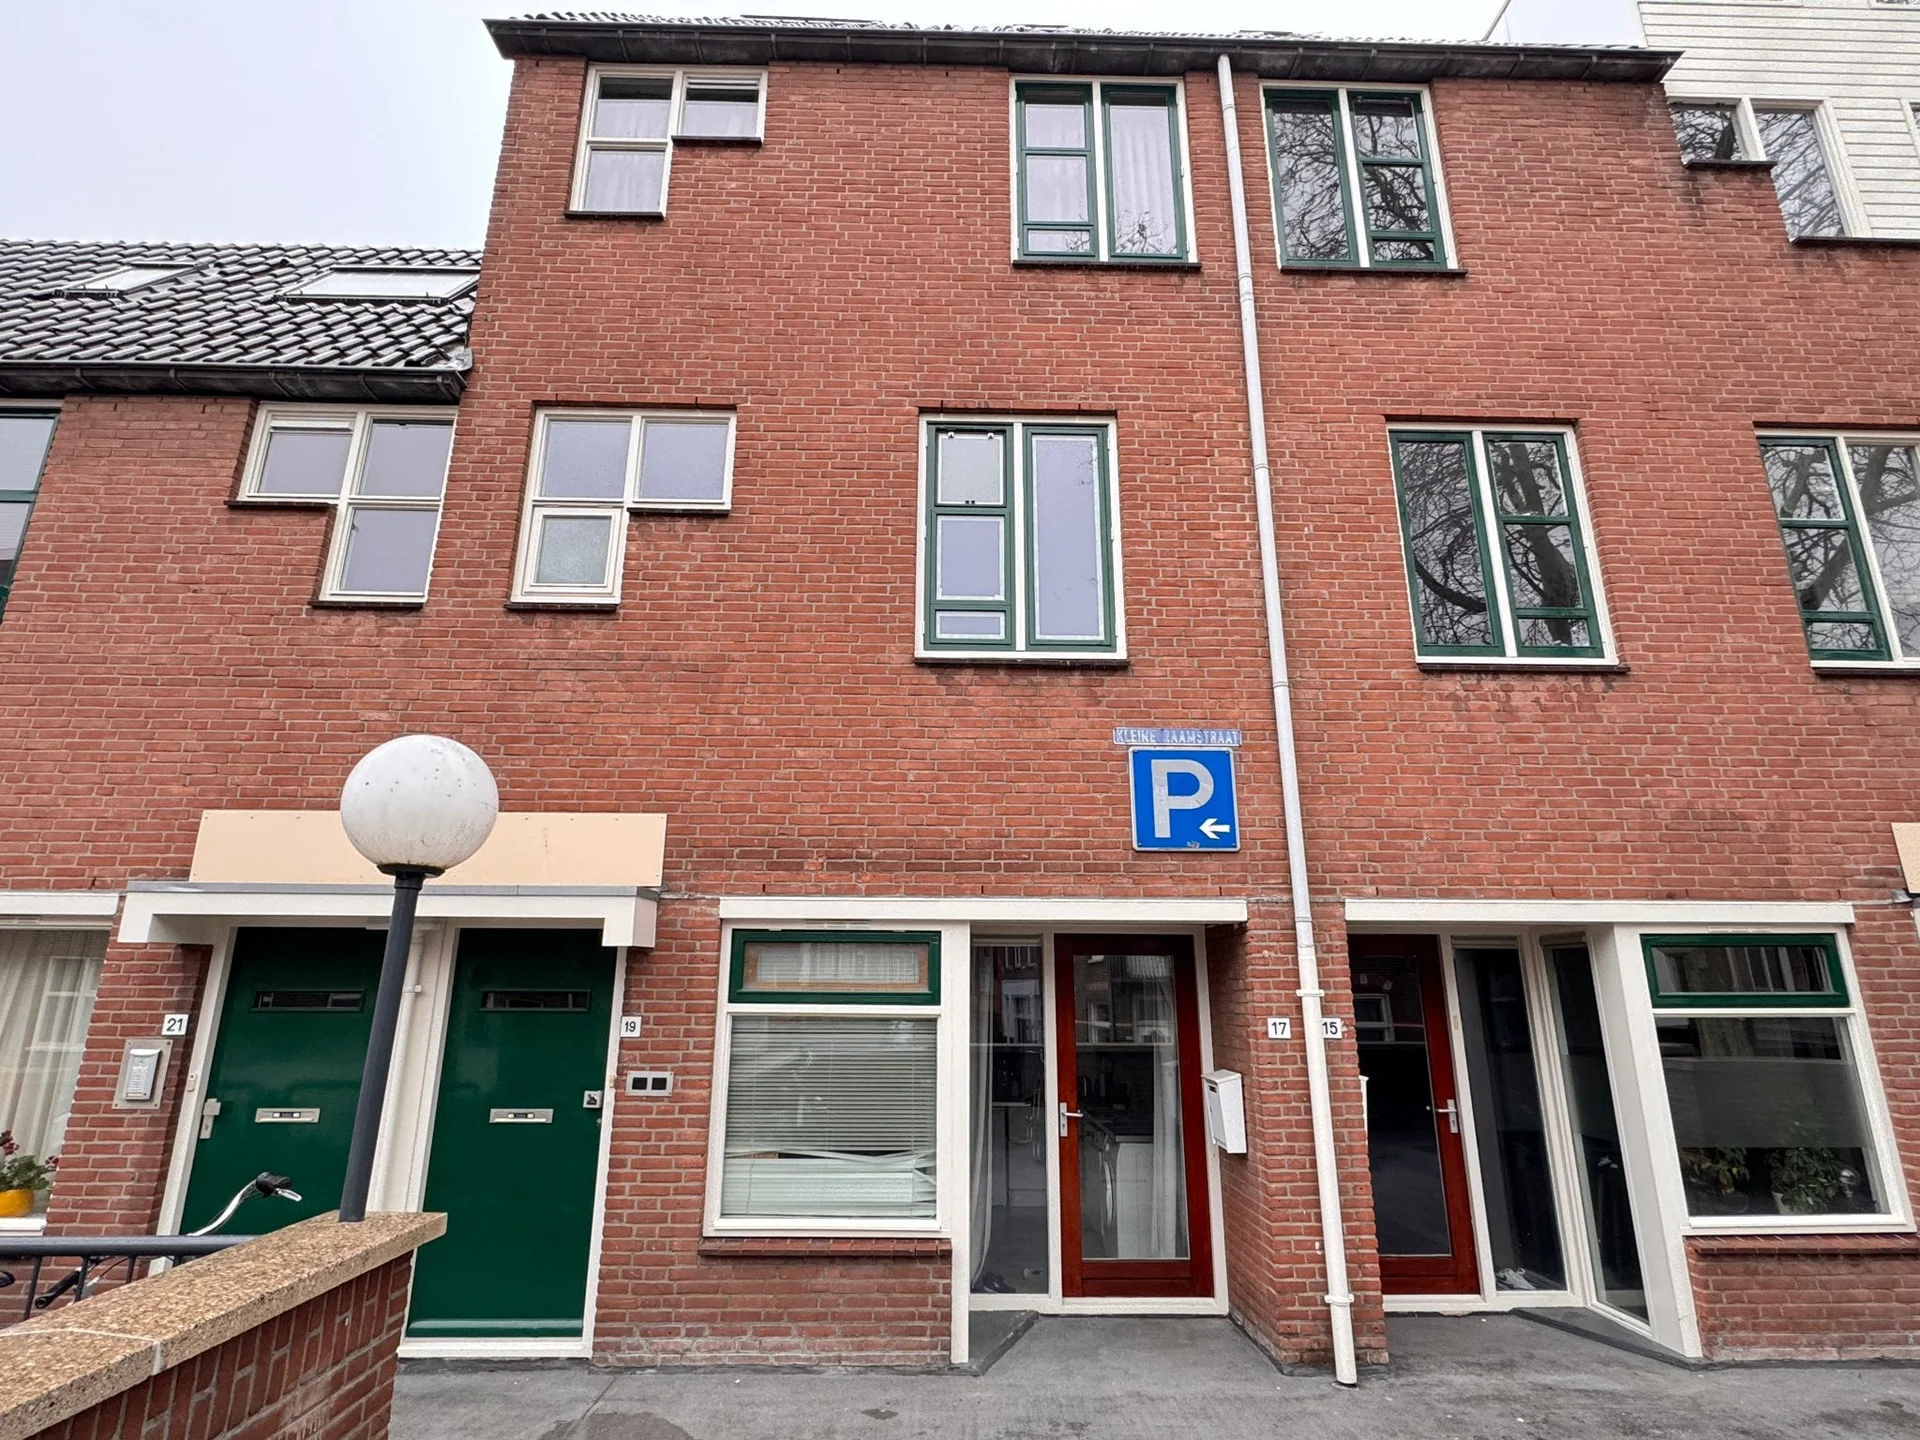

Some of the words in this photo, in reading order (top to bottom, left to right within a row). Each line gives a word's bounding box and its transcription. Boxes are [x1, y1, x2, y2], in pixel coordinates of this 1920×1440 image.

[1116, 729, 1156, 742] KLEINE
[1163, 730, 1238, 744] RAAMSTRAAT
[1151, 759, 1214, 838] P
[166, 1018, 183, 1032] 21
[625, 1021, 636, 1032] 19
[1271, 1022, 1287, 1035] 17
[1322, 1022, 1338, 1035] 15
